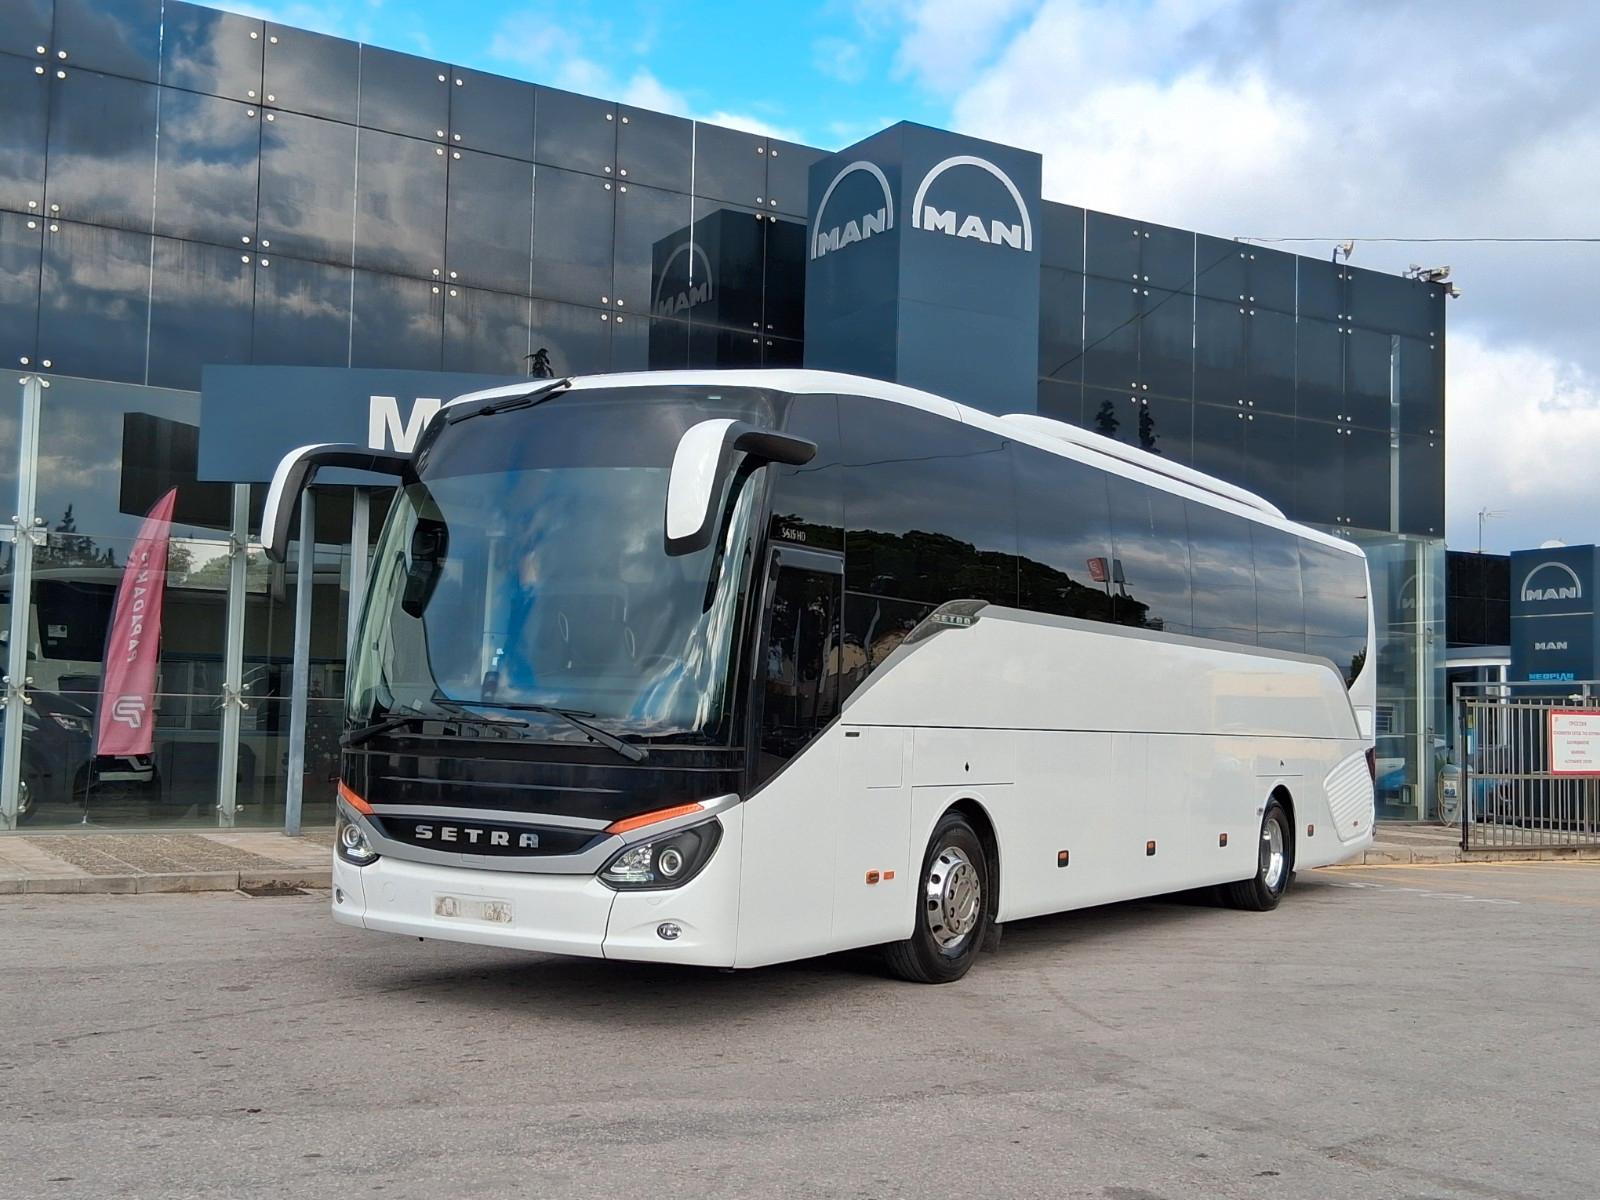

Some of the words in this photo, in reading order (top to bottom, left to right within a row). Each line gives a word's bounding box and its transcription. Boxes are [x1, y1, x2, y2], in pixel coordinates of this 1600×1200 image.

[817, 207, 886, 257] MAN
[923, 205, 1022, 249] MAN
[1526, 587, 1577, 601] MAN
[1534, 642, 1568, 650] MAN
[1528, 672, 1574, 681] NEOPLAN
[415, 824, 540, 849] SETRA
